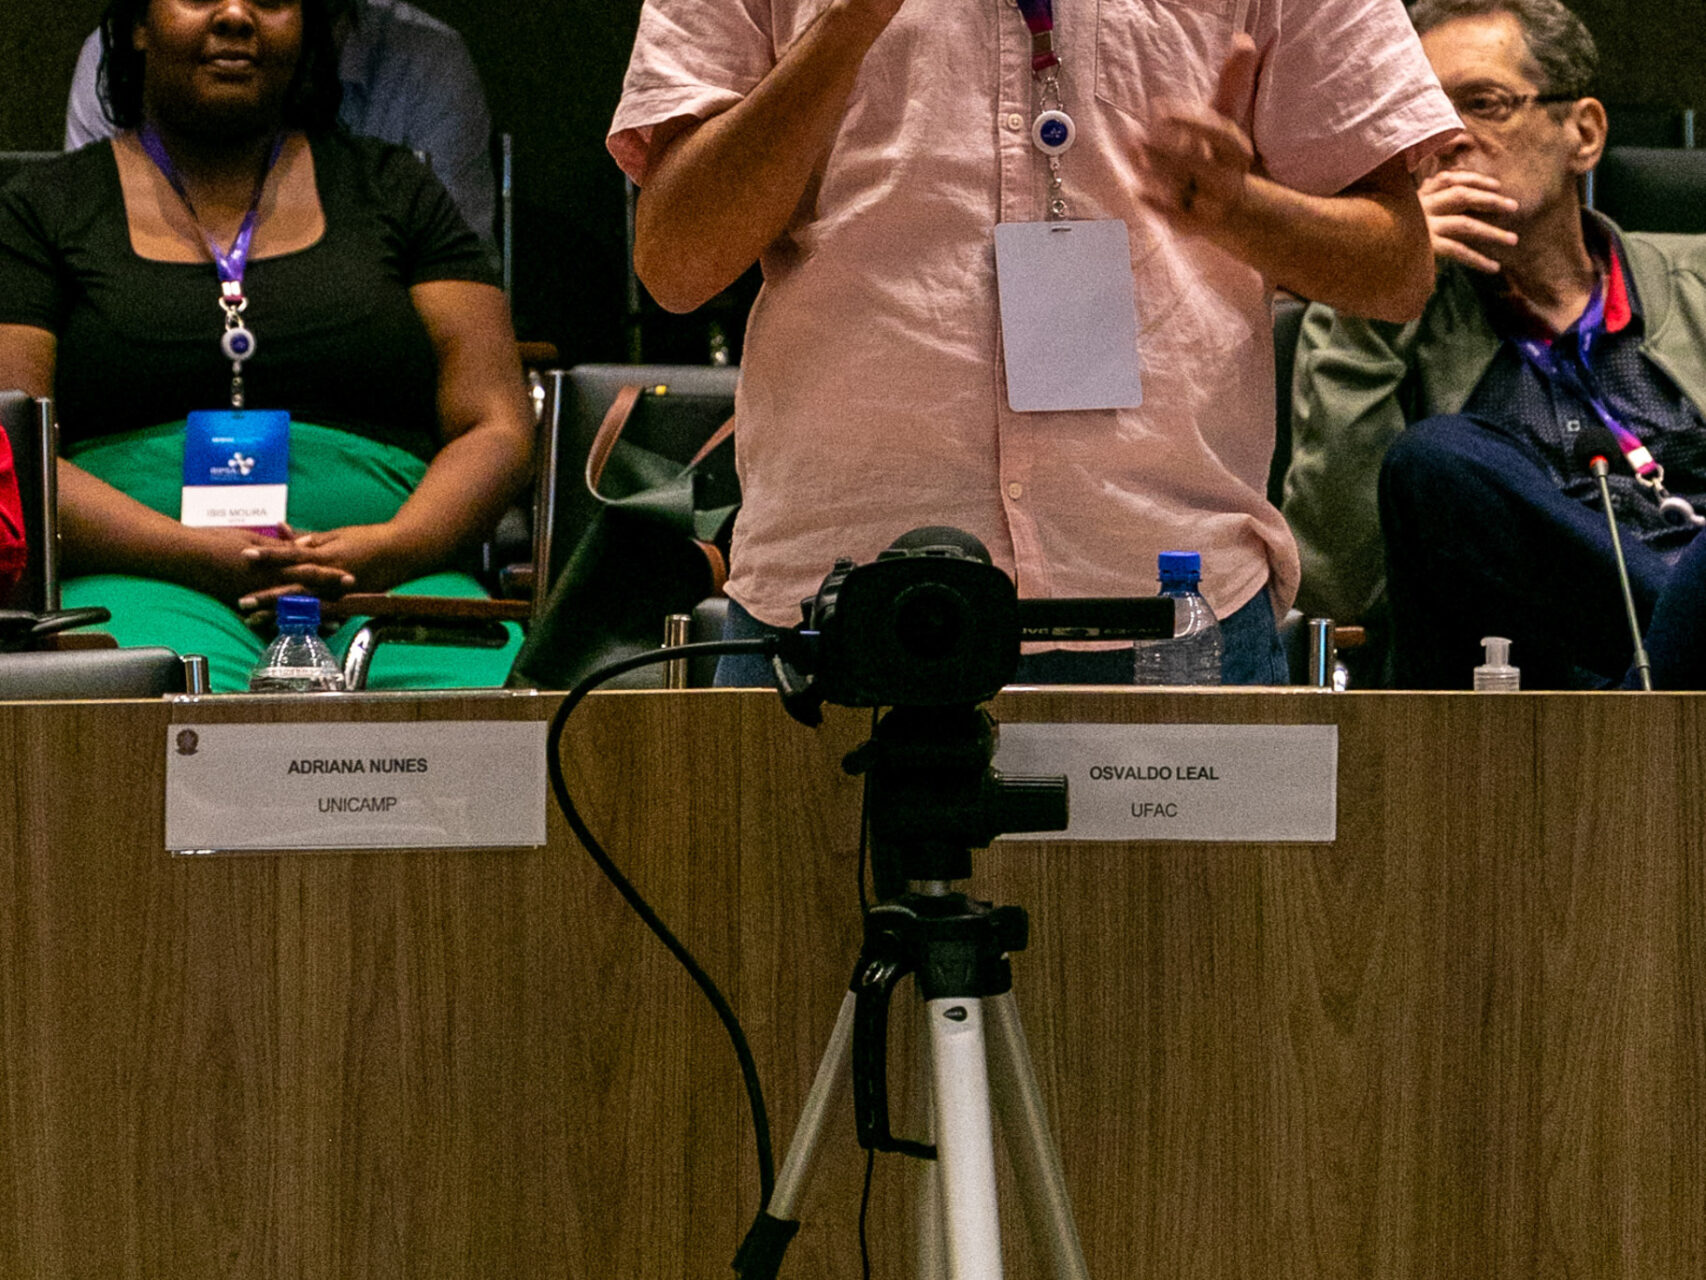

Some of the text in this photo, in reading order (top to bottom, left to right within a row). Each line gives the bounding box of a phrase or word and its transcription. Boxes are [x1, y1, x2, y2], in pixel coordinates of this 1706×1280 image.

[287, 758, 428, 775] ADRIANA NUNES
[1089, 766, 1219, 781] OSVALDO LEAL
[318, 796, 398, 813] UNICAMP
[1131, 802, 1178, 818] UFAC
